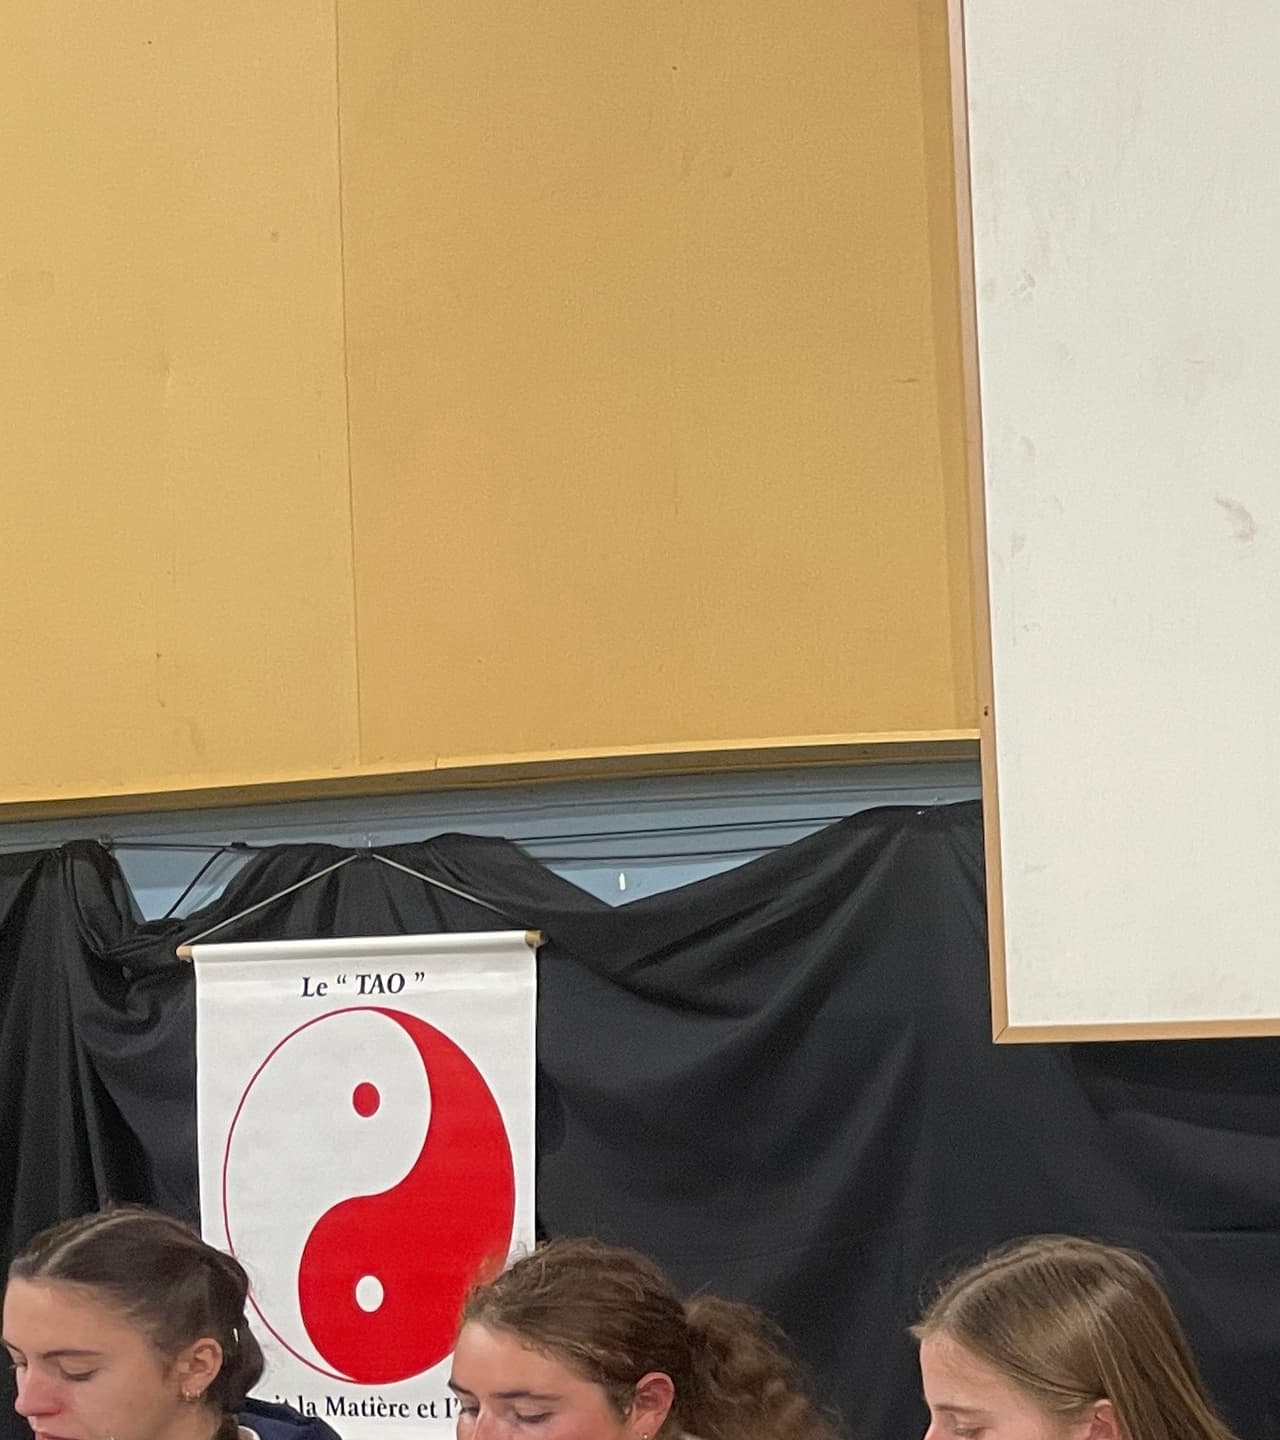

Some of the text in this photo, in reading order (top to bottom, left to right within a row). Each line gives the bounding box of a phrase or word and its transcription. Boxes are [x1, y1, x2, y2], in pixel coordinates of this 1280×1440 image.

[302, 976, 329, 998] Le
[355, 972, 406, 996] TAO
[298, 1395, 318, 1417] la
[325, 1395, 411, 1418] Matière
[411, 1399, 438, 1418] et
[444, 1396, 459, 1419] l’
